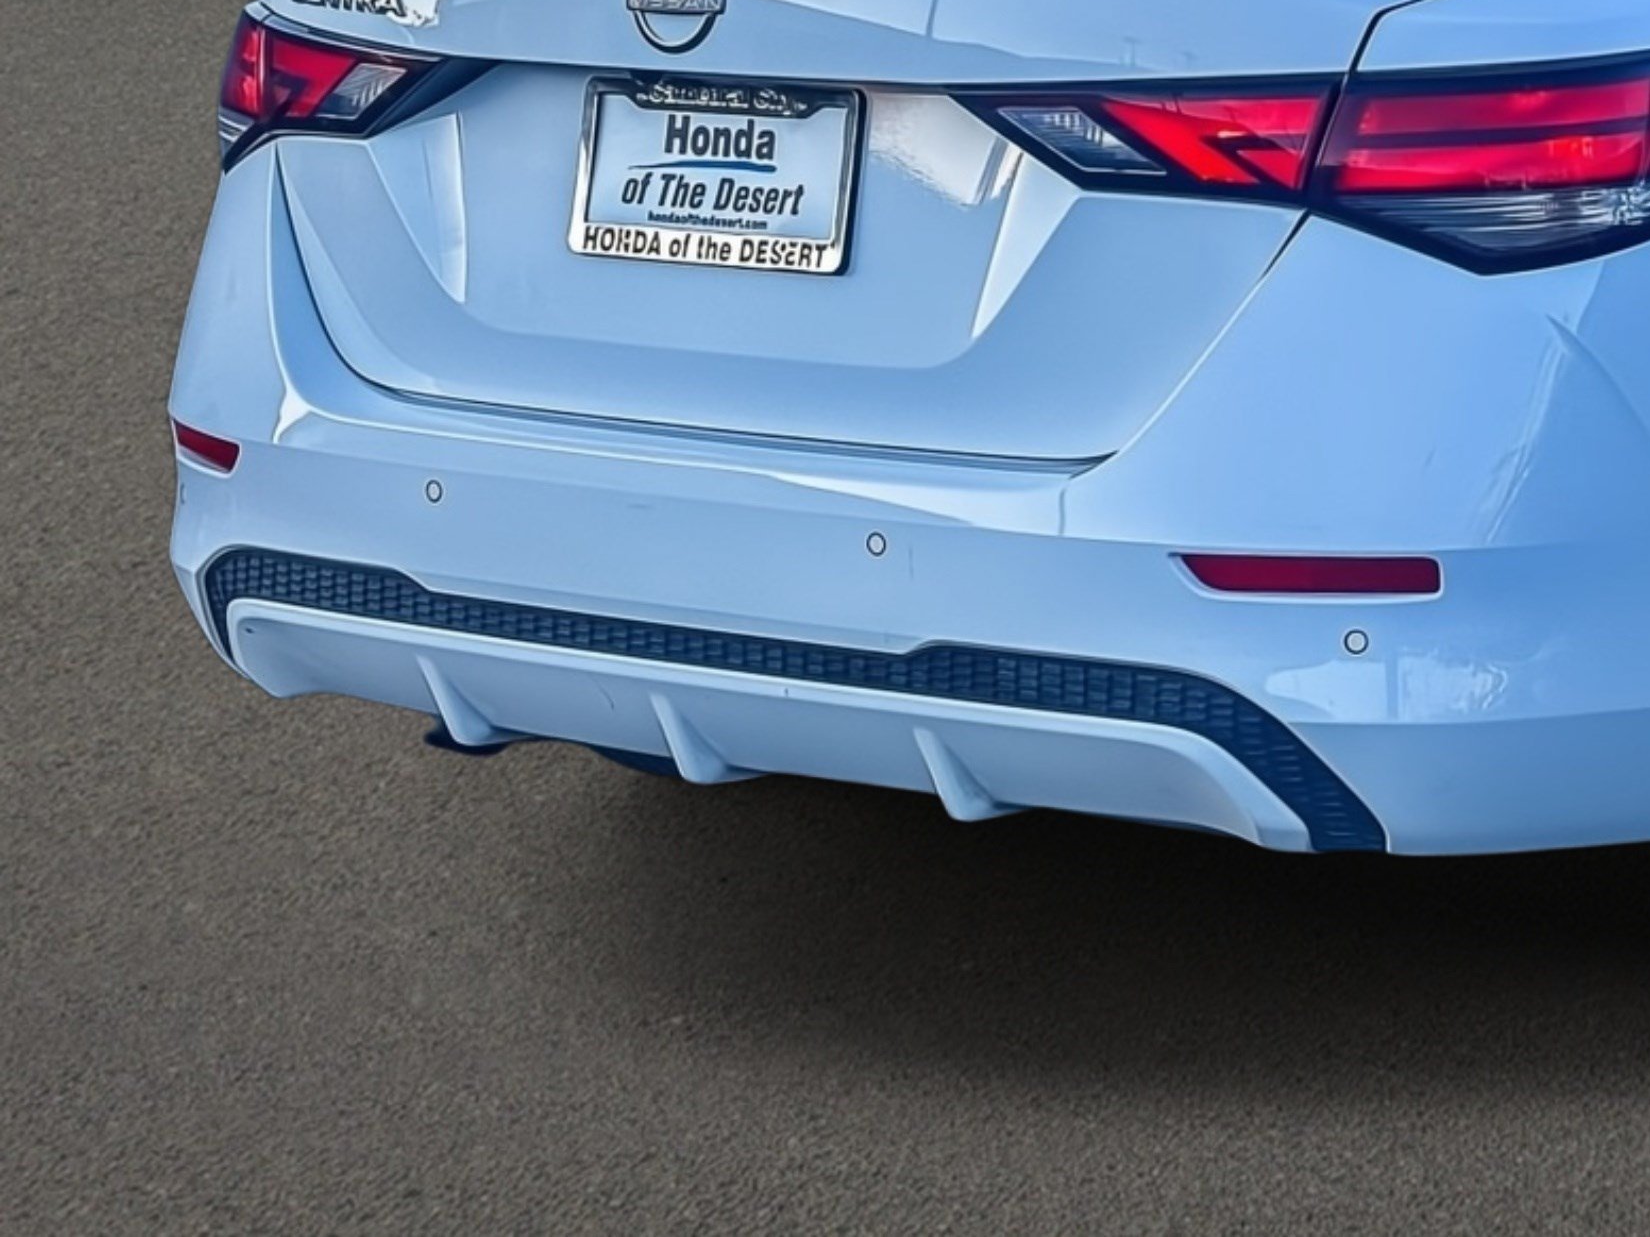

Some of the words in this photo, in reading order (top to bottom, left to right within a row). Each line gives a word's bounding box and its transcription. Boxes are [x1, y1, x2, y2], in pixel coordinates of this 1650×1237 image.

[663, 114, 776, 161] Honda
[621, 171, 655, 205] of
[657, 173, 707, 210] The
[713, 177, 805, 216] Desert
[583, 225, 661, 256] HONDA
[668, 233, 692, 258] of
[696, 235, 731, 262] the
[738, 239, 828, 269] DESERT
